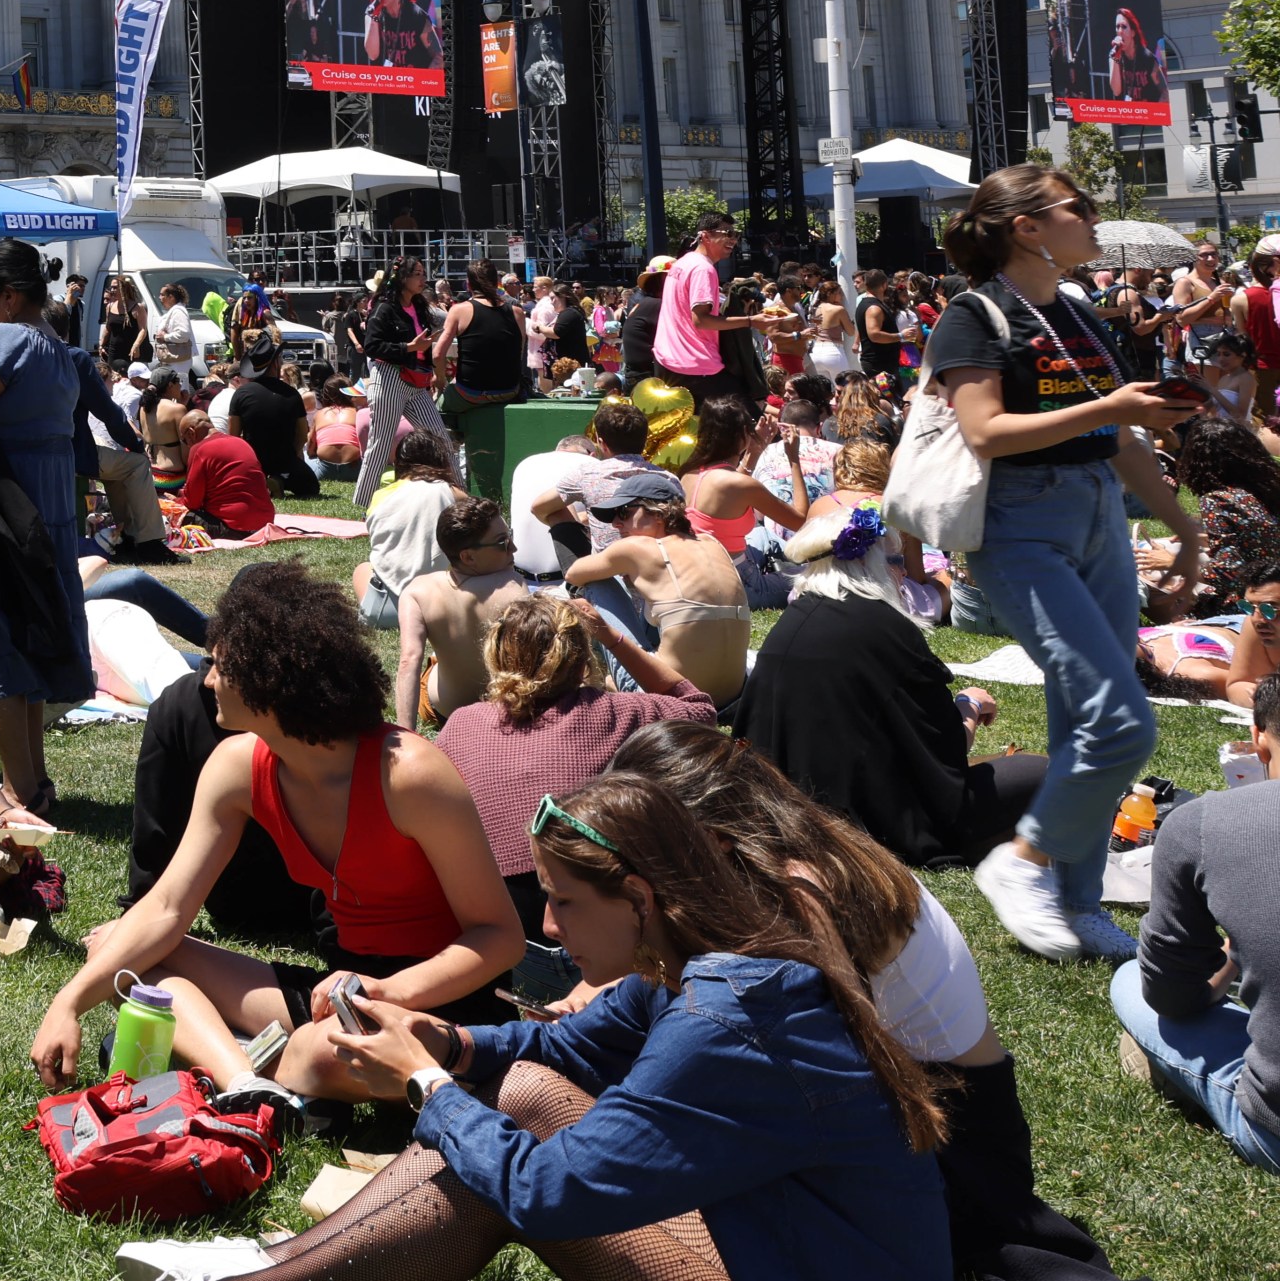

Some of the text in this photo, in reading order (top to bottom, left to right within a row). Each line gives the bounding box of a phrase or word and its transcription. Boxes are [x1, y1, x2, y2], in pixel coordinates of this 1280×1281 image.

[482, 28, 514, 40] LIGHTS
[483, 42, 500, 53] ARE
[116, 2, 150, 107] LIGHT
[484, 54, 496, 64] ON
[321, 68, 415, 83] Cruise as you are
[1079, 103, 1148, 115] Cruise as you are
[6, 213, 96, 230] BUD LIGHT
